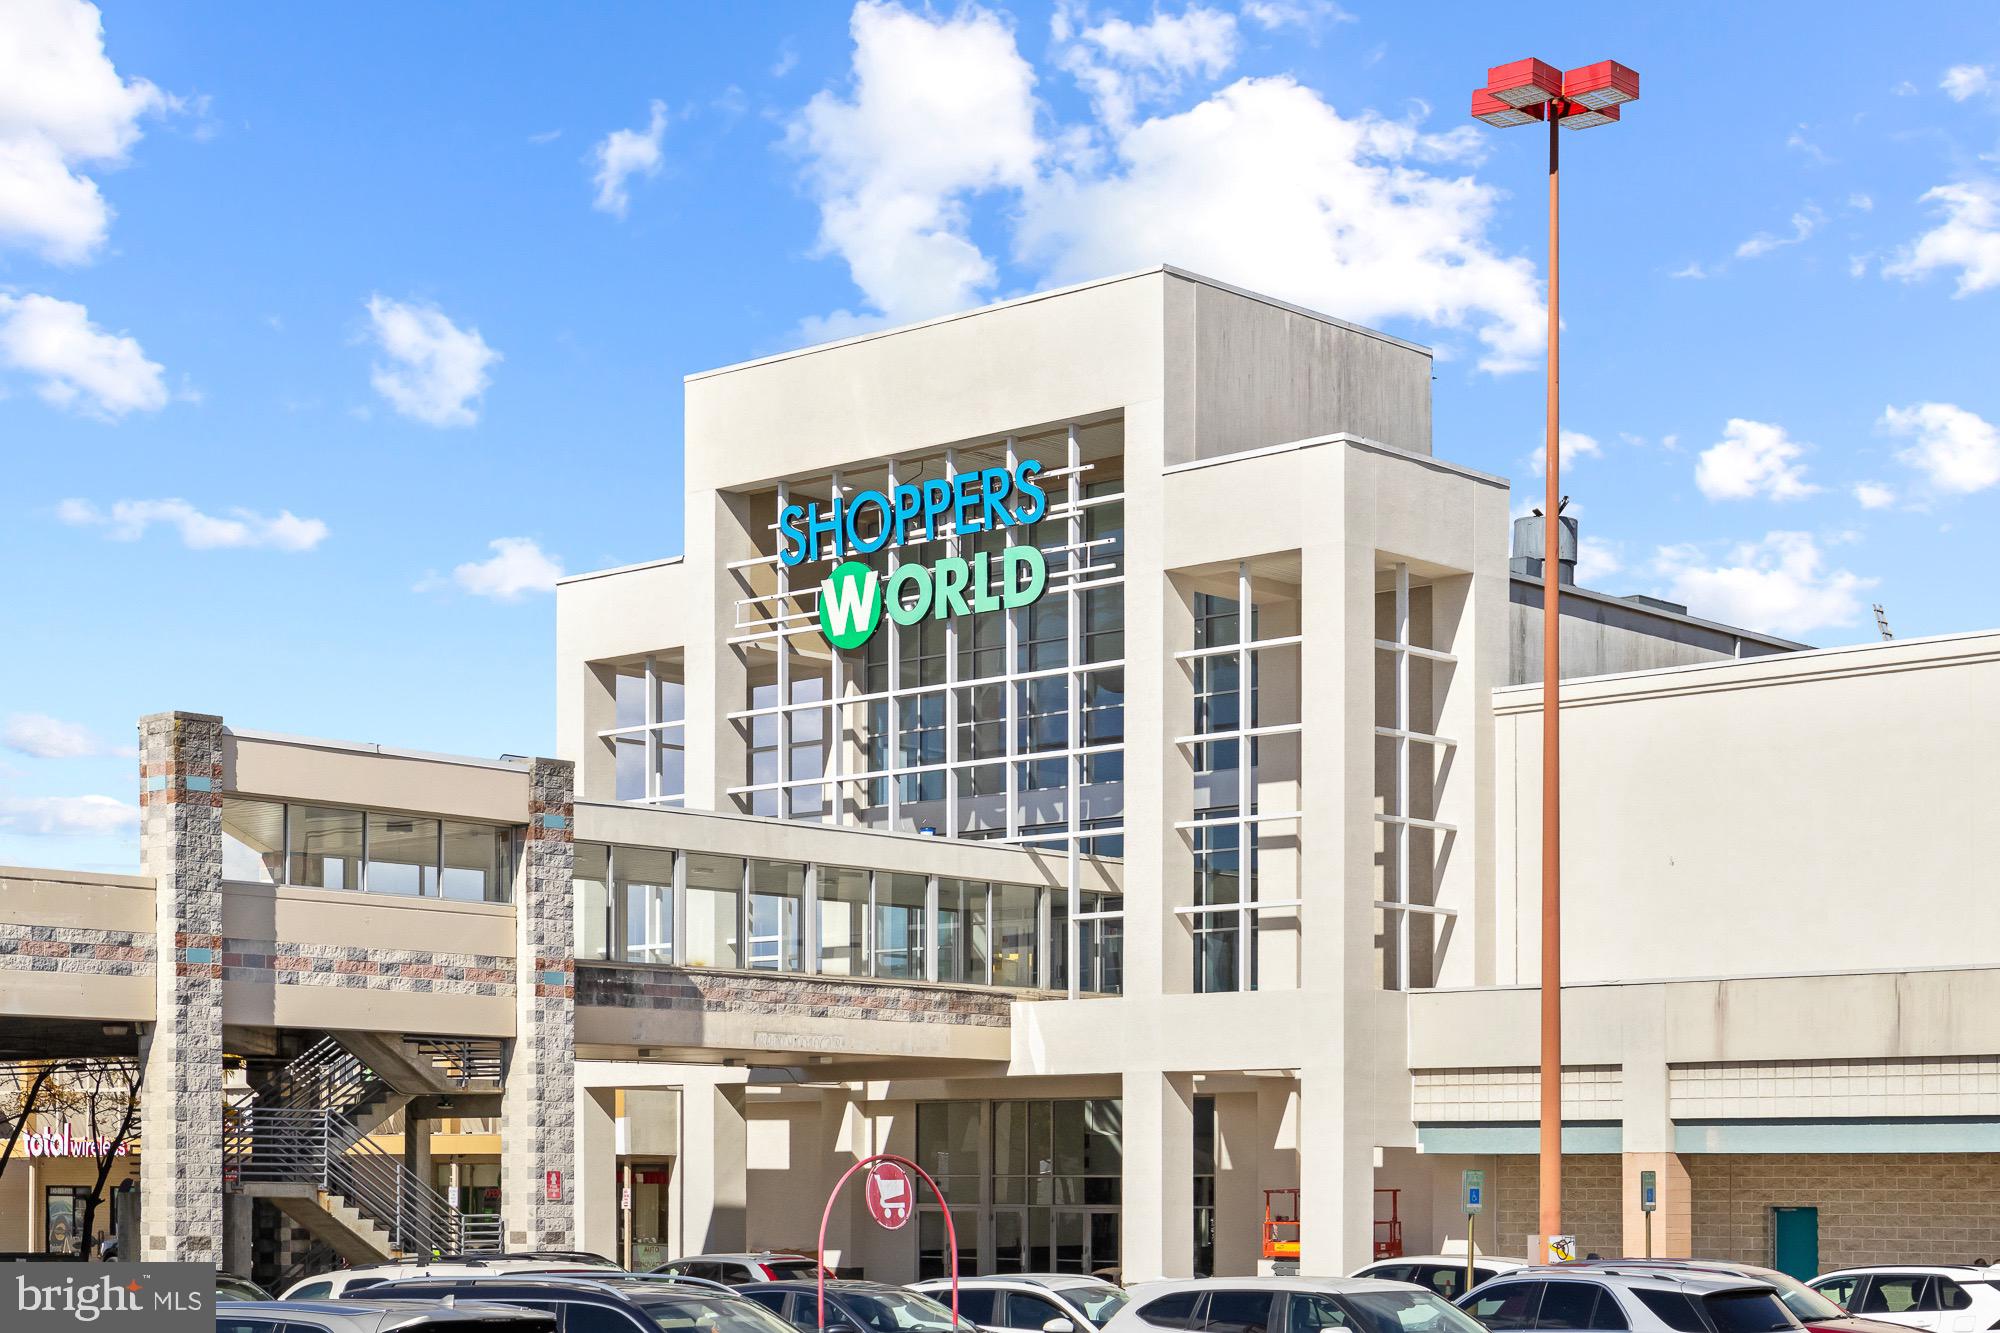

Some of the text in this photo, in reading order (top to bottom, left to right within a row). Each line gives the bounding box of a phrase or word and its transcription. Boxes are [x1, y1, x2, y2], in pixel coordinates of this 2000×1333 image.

[780, 459, 1048, 566] SHOPPERS
[820, 545, 1048, 637] WORLD
[22, 1122, 129, 1158] total wireles
